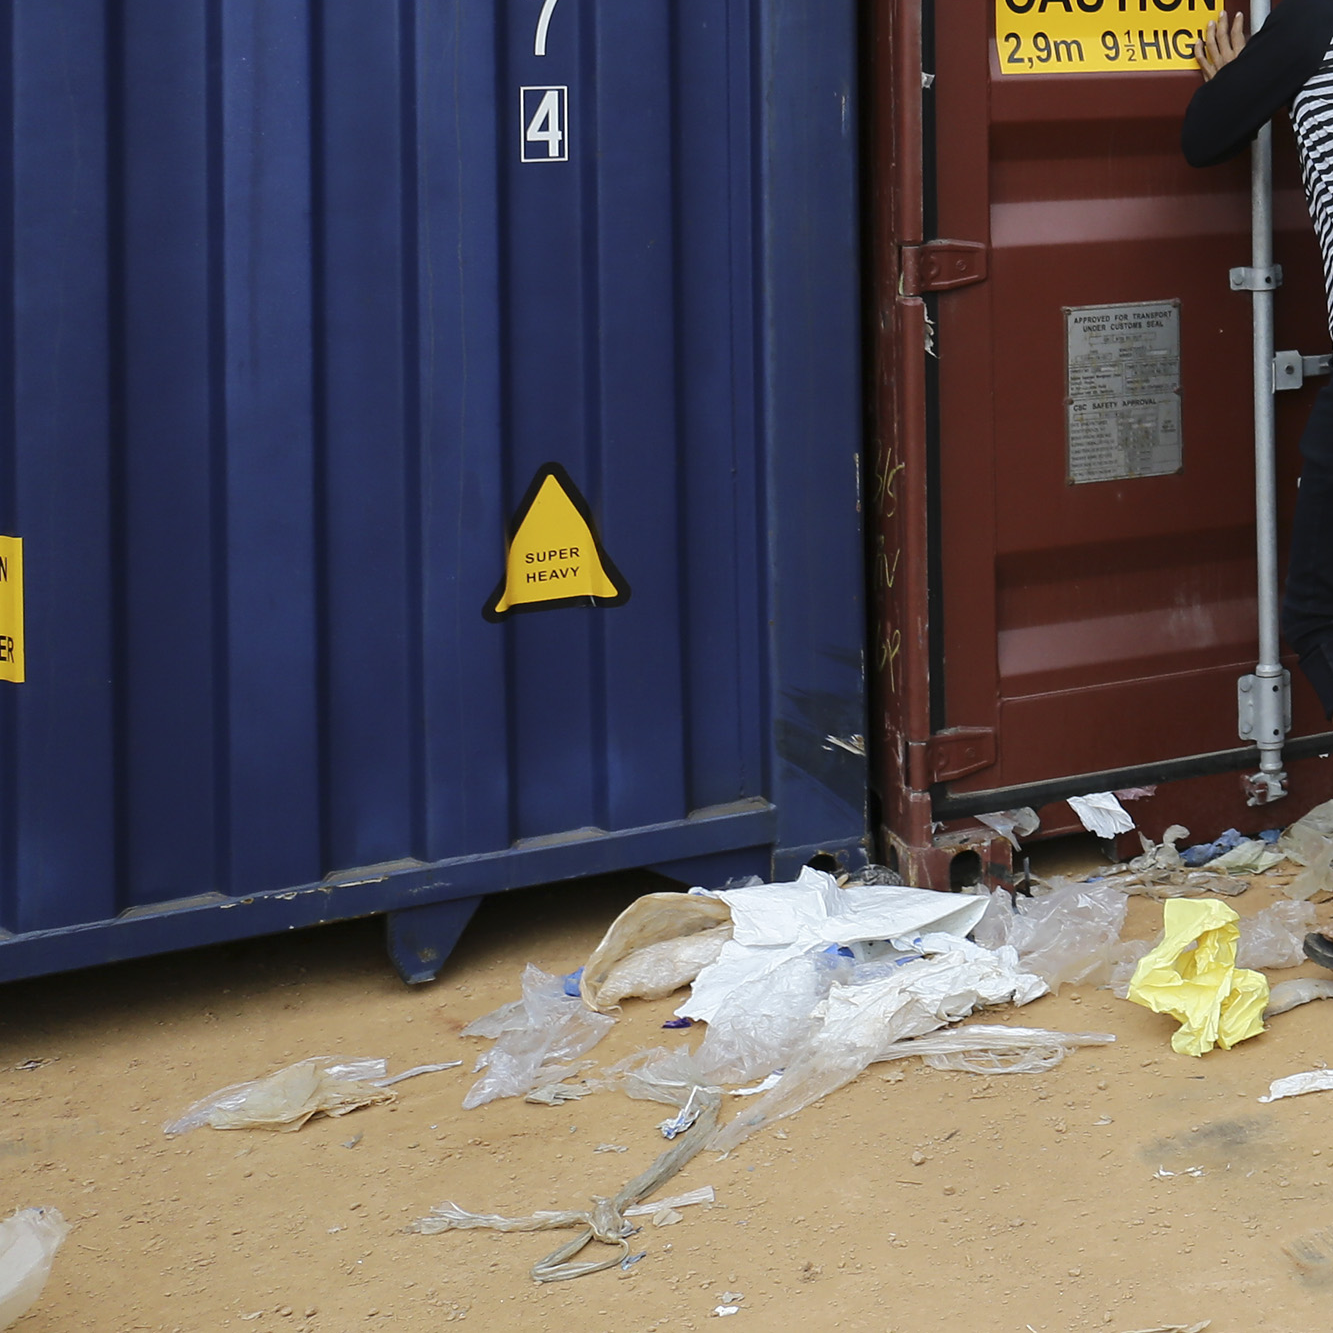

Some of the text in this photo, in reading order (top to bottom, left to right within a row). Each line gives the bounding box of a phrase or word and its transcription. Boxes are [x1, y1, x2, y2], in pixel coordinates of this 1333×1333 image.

[1004, 32, 1085, 69] 2,9m
[1138, 28, 1206, 60] HIG
[525, 91, 563, 156] 4
[1073, 310, 1172, 324] APPROVED FOR TRANSPORT
[1083, 319, 1164, 333] UNDER CUSTOMS SEAL
[1092, 401, 1118, 409] SAFETY
[1122, 398, 1157, 407] APPROVAL
[525, 547, 580, 564] SUPER
[526, 567, 580, 584] HEAVY
